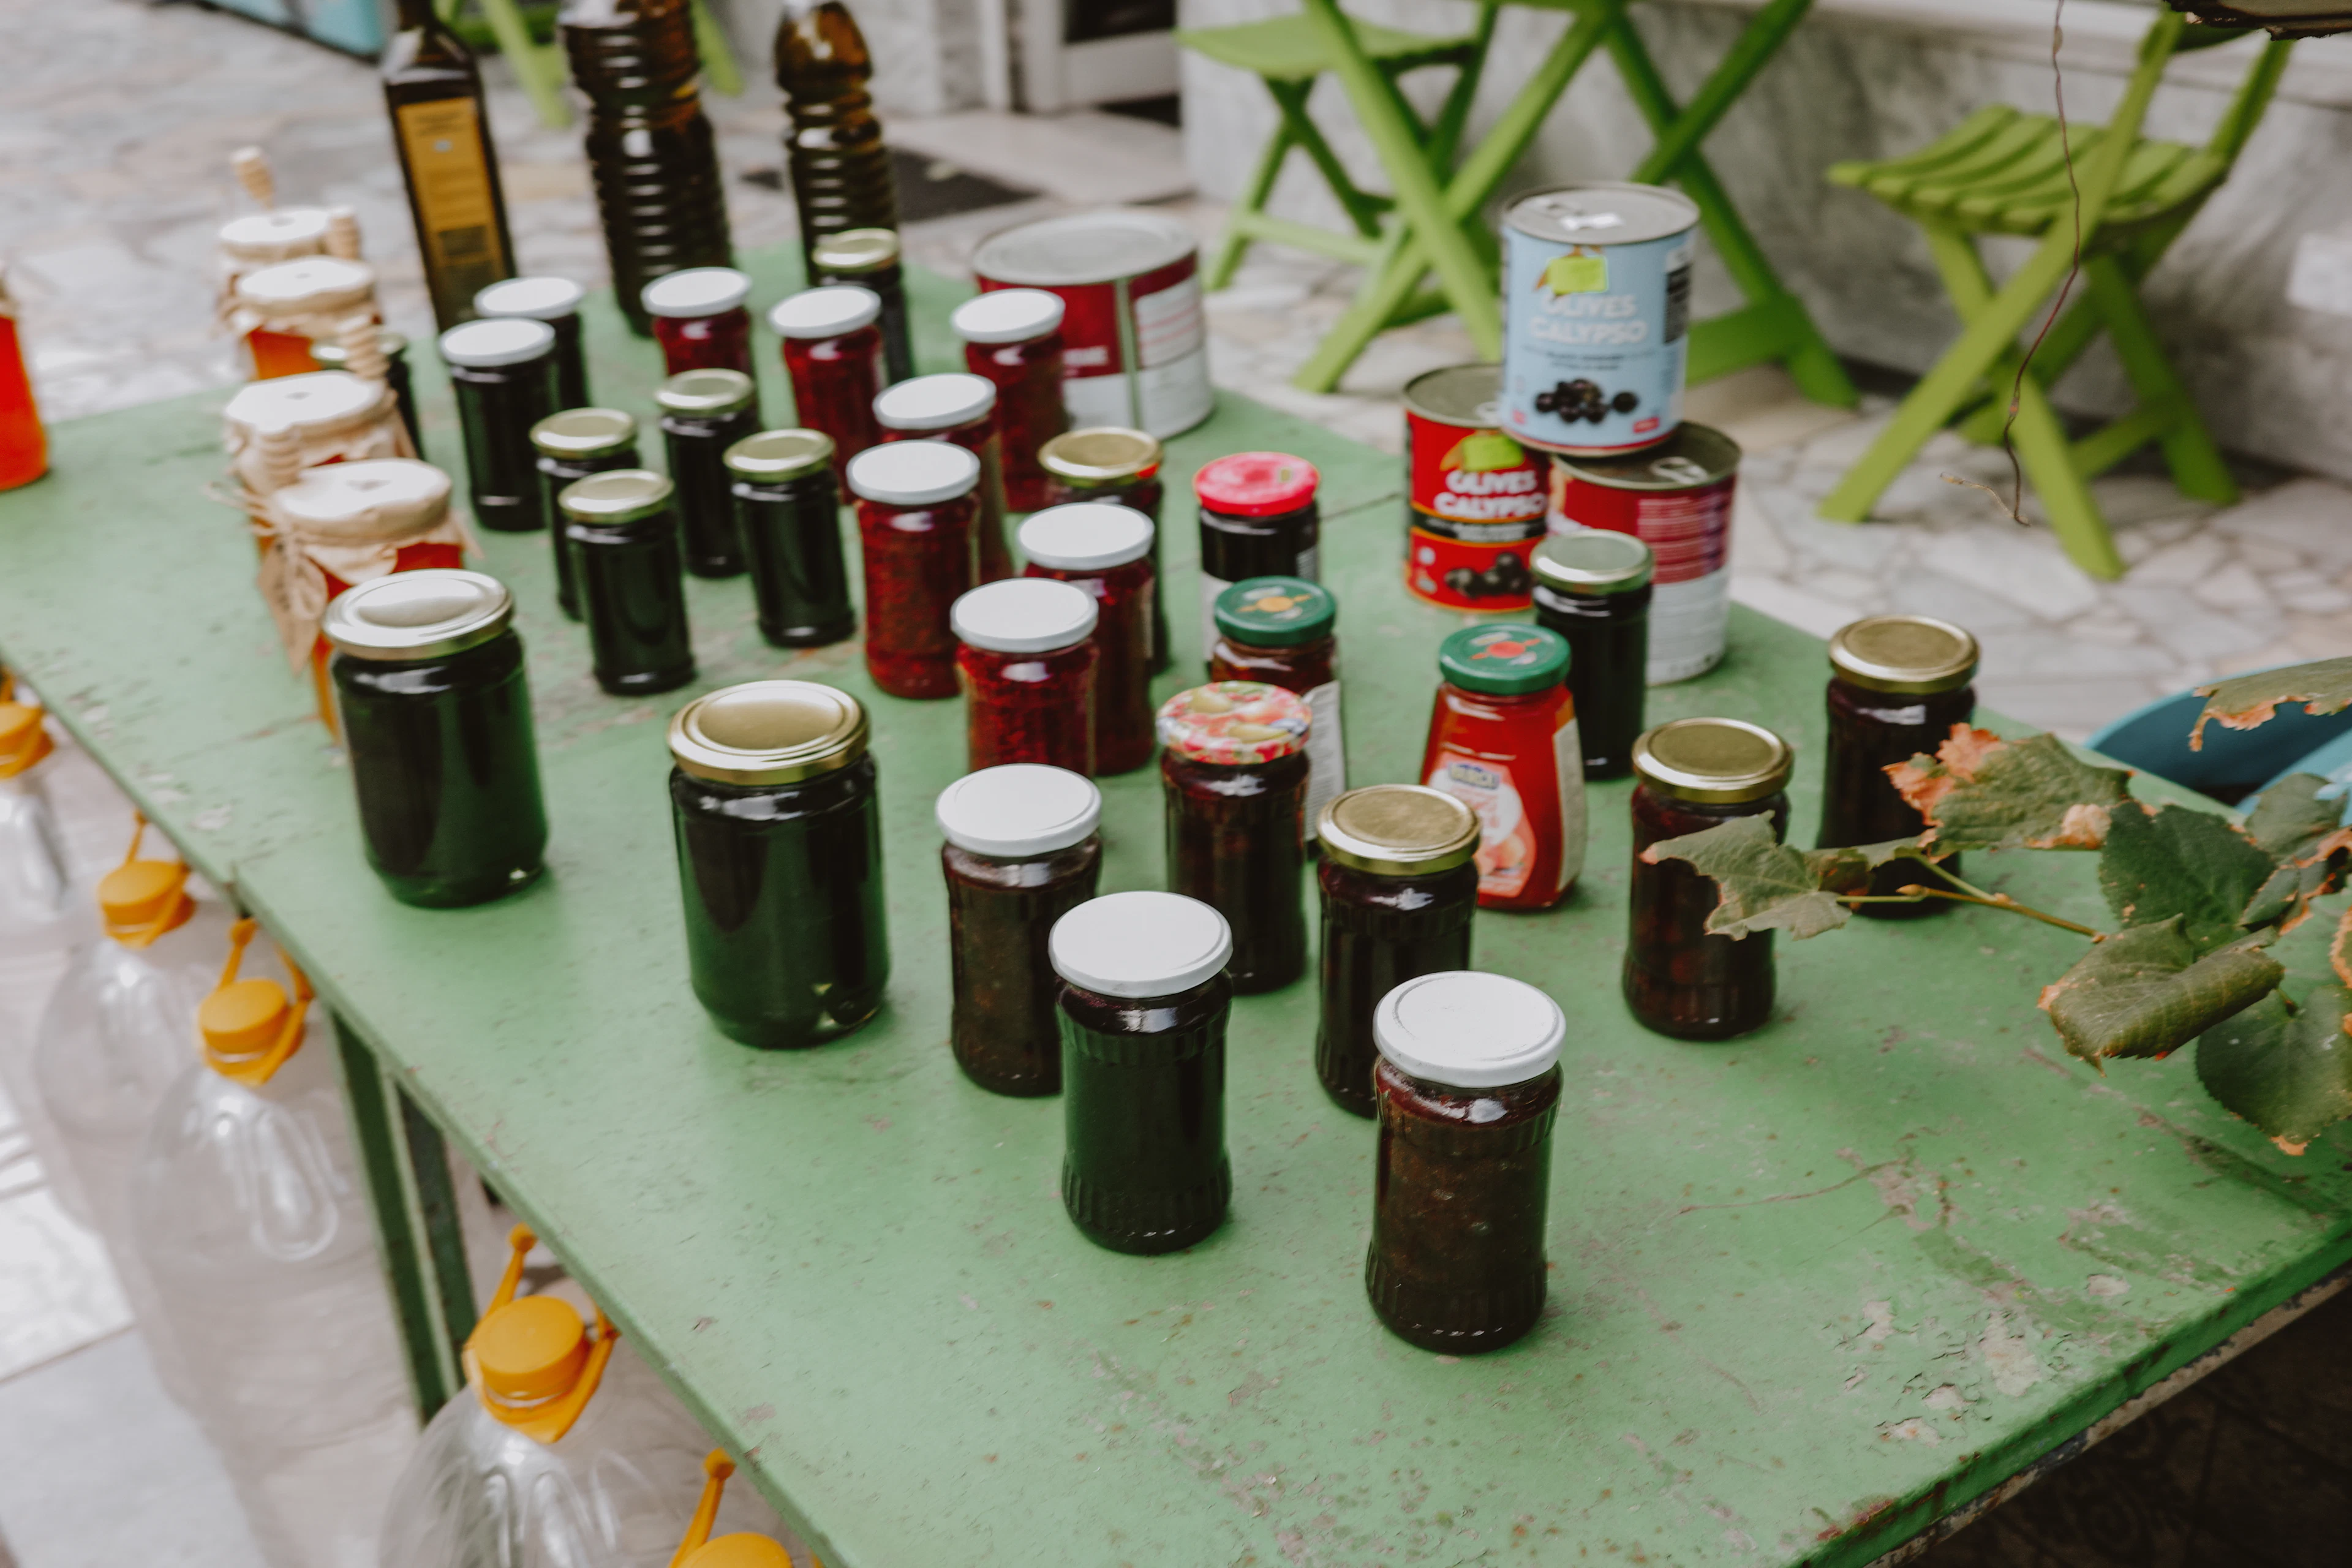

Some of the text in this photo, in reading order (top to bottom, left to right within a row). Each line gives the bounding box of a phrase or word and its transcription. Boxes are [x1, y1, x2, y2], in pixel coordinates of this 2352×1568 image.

[1542, 293, 1637, 319] OLIVES
[1529, 316, 1648, 345] CALYPSO
[1446, 469, 1537, 496] OLIVES
[1433, 491, 1547, 519] CALYPSO
